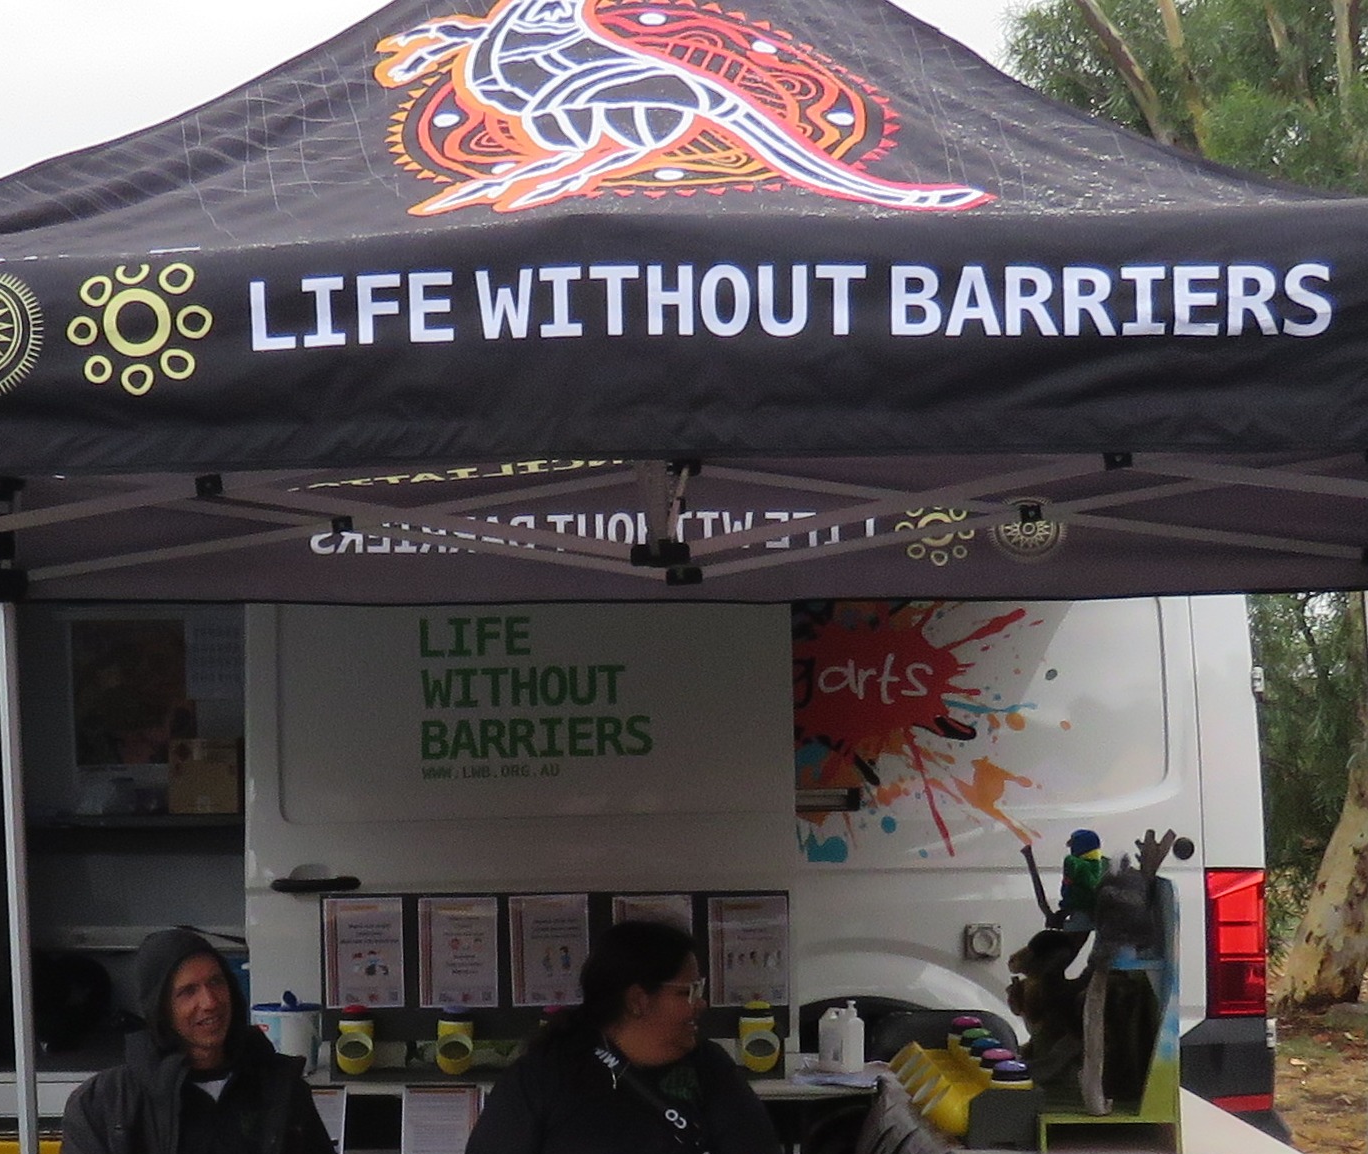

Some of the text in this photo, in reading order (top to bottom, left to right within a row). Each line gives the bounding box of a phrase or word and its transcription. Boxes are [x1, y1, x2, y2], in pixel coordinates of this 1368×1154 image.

[249, 261, 1333, 352] LIFE WITHOUT BARRIERS
[418, 616, 532, 658] LIFE
[421, 664, 626, 710] WITHOUT
[817, 652, 934, 705] arts
[420, 715, 654, 760] BARRIERS
[421, 764, 561, 780] WWW.LWB.ORG.AU
